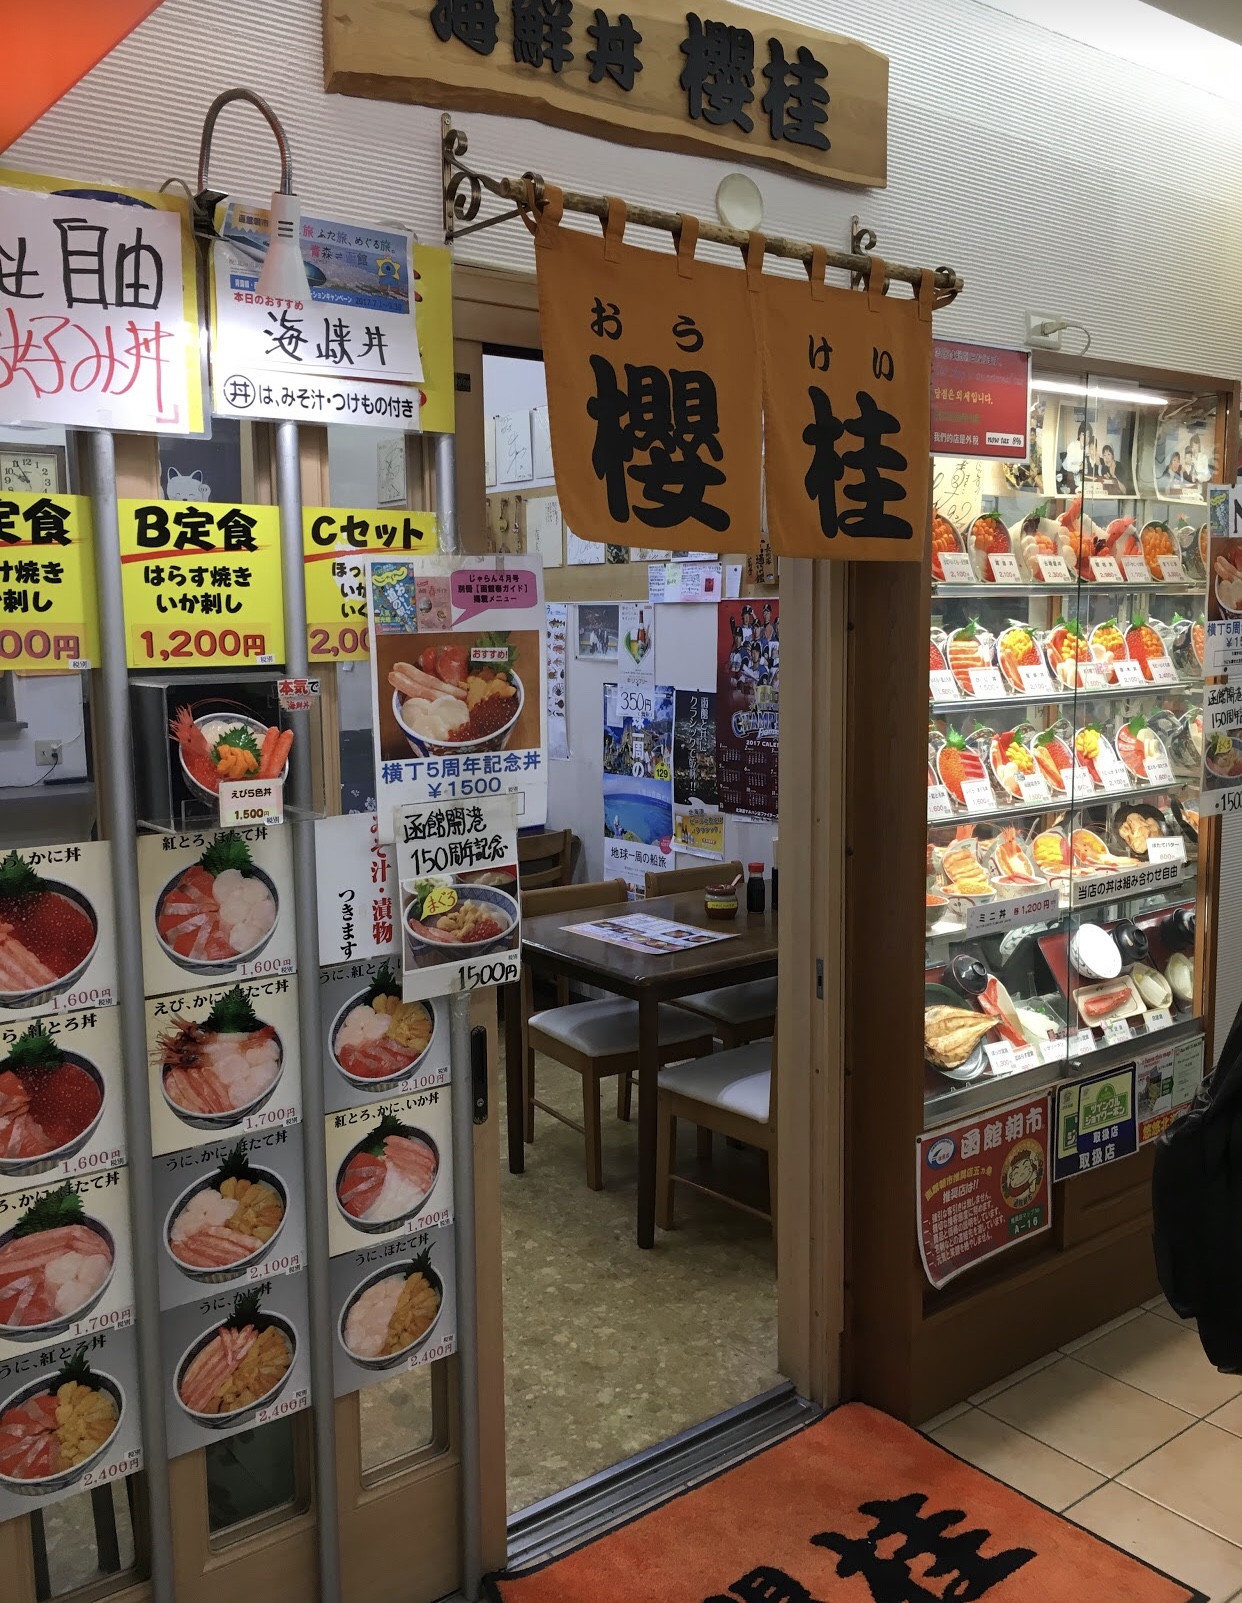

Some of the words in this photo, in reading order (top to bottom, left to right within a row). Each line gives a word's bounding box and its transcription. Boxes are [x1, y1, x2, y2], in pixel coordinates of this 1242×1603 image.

[680, 12, 832, 150] 櫻桂
[234, 292, 303, 310] 本日のおすすめ
[263, 309, 389, 366] 海峡丼
[134, 506, 258, 552] B定食
[311, 515, 424, 549] Cセット
[144, 565, 252, 588] はらす焼き
[469, 574, 520, 583] じゃらん4月号
[156, 592, 243, 614] いか刺し
[473, 595, 517, 603] 掲載メニュー
[1207, 621, 1242, 636] 横丁5周
[140, 629, 265, 661] 1,200円
[620, 691, 652, 712] 350円
[382, 751, 541, 784] 横丁5周年記念丼
[656, 768, 668, 779] 129
[231, 788, 272, 799] えび5色丼
[404, 806, 487, 843] 函館開港
[162, 827, 268, 851] 紅とろ、ほたて丼
[411, 835, 508, 875] 150周年記念
[611, 846, 667, 869] 地球一周の船旅
[1078, 864, 1178, 900] 当店の丼は組み合わせ自由
[338, 889, 358, 961] つきます
[458, 962, 518, 990] 1500円
[334, 1091, 439, 1128] 紅とろ、かに、いか丼
[960, 1107, 1042, 1160] 函館朝市
[1093, 1125, 1119, 1143] 取扱店
[1079, 1143, 1115, 1169] 取扱店
[355, 1232, 429, 1266] うに、ほたて丼
